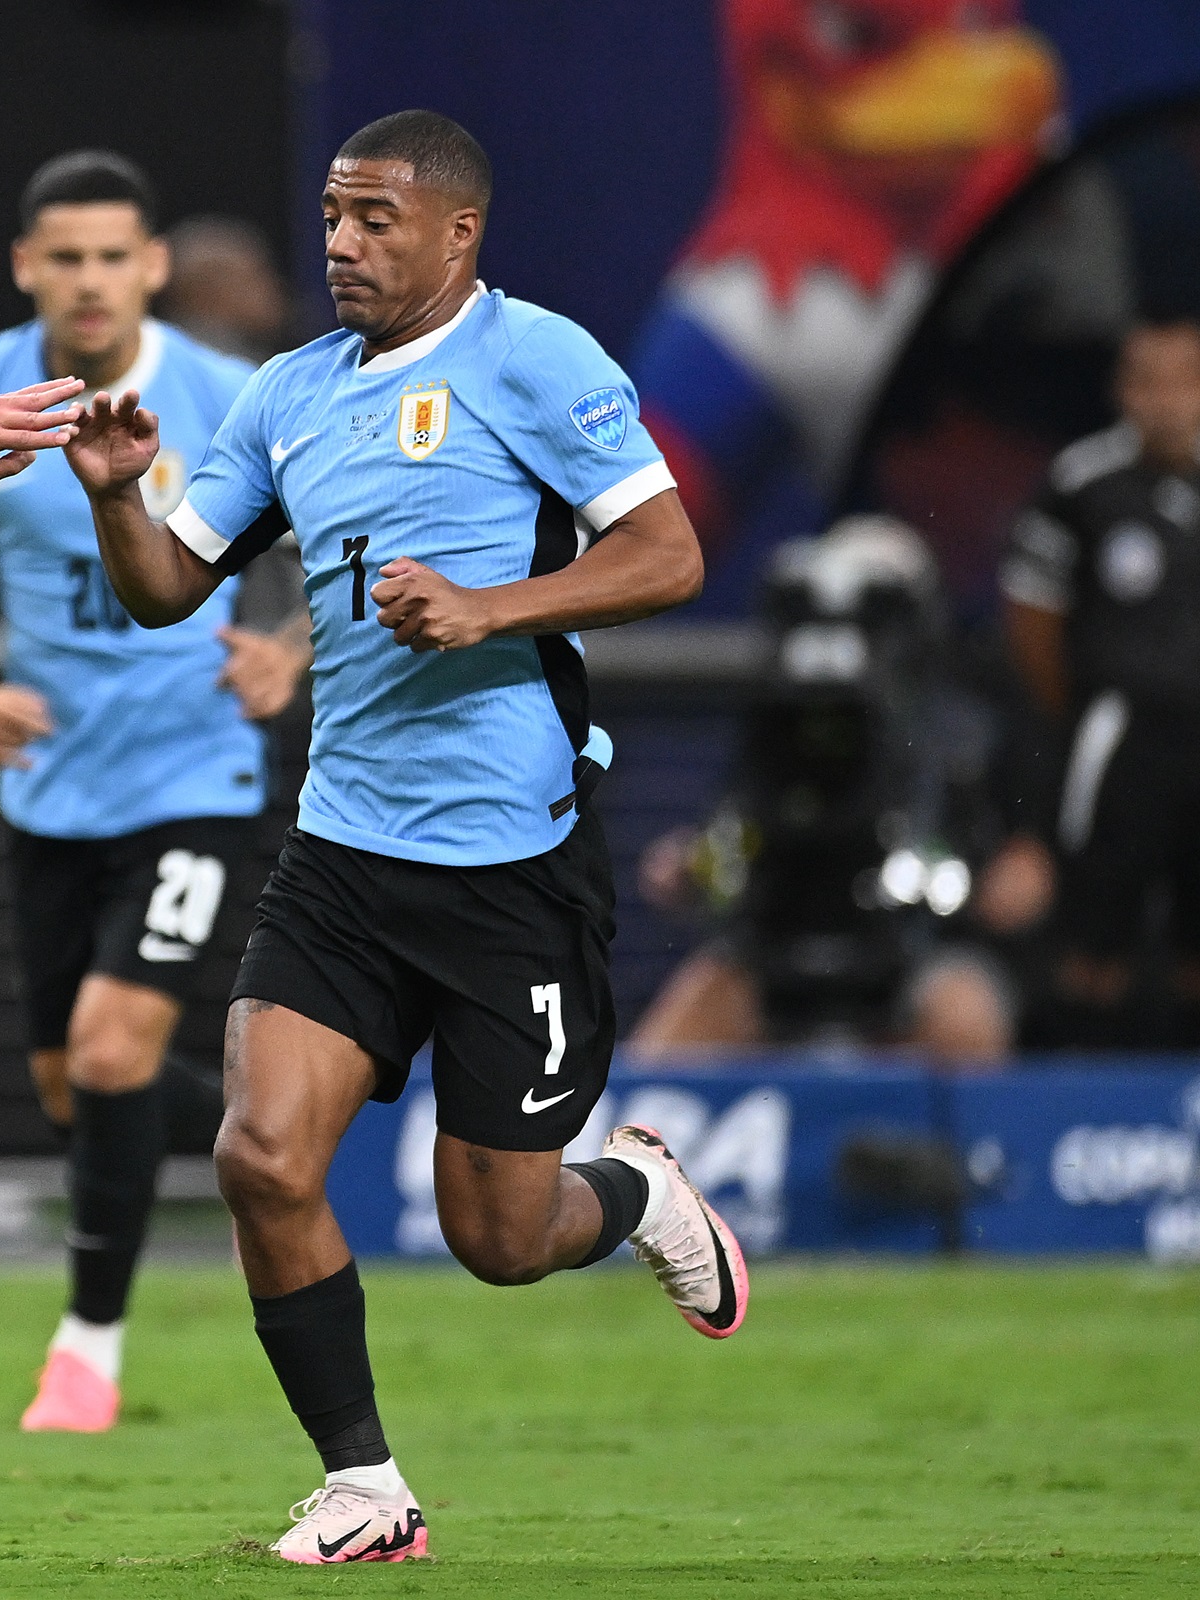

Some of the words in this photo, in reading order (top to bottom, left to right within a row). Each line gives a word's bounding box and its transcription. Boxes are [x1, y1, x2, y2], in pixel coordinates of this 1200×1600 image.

[417, 404, 429, 428] AUF
[580, 400, 619, 426] VIBRA
[340, 534, 369, 622] 7
[144, 849, 227, 946] 20
[530, 982, 566, 1075] 7
